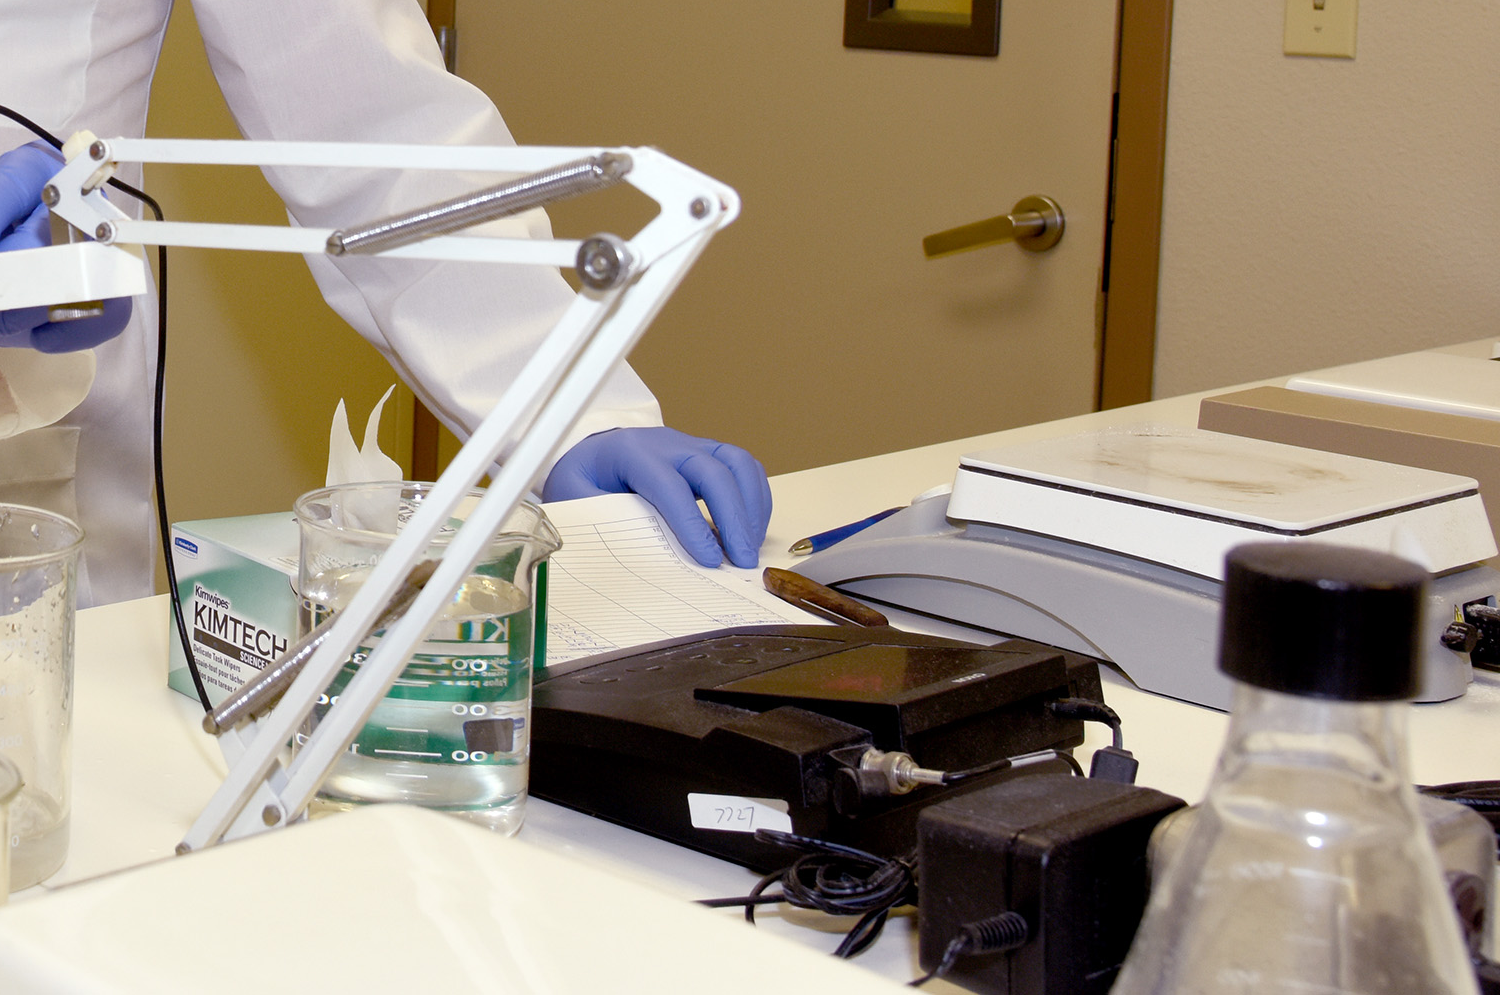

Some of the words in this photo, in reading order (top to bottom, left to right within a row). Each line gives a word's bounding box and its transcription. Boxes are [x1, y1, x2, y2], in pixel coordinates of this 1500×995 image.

[195, 585, 230, 611] Kimwipes
[194, 600, 288, 661] KIMTECH
[193, 643, 212, 660] Delicate
[211, 652, 223, 666] Task
[223, 657, 242, 673] Wipers
[207, 675, 218, 686] para
[218, 680, 233, 693] tareas
[218, 668, 229, 679] pour
